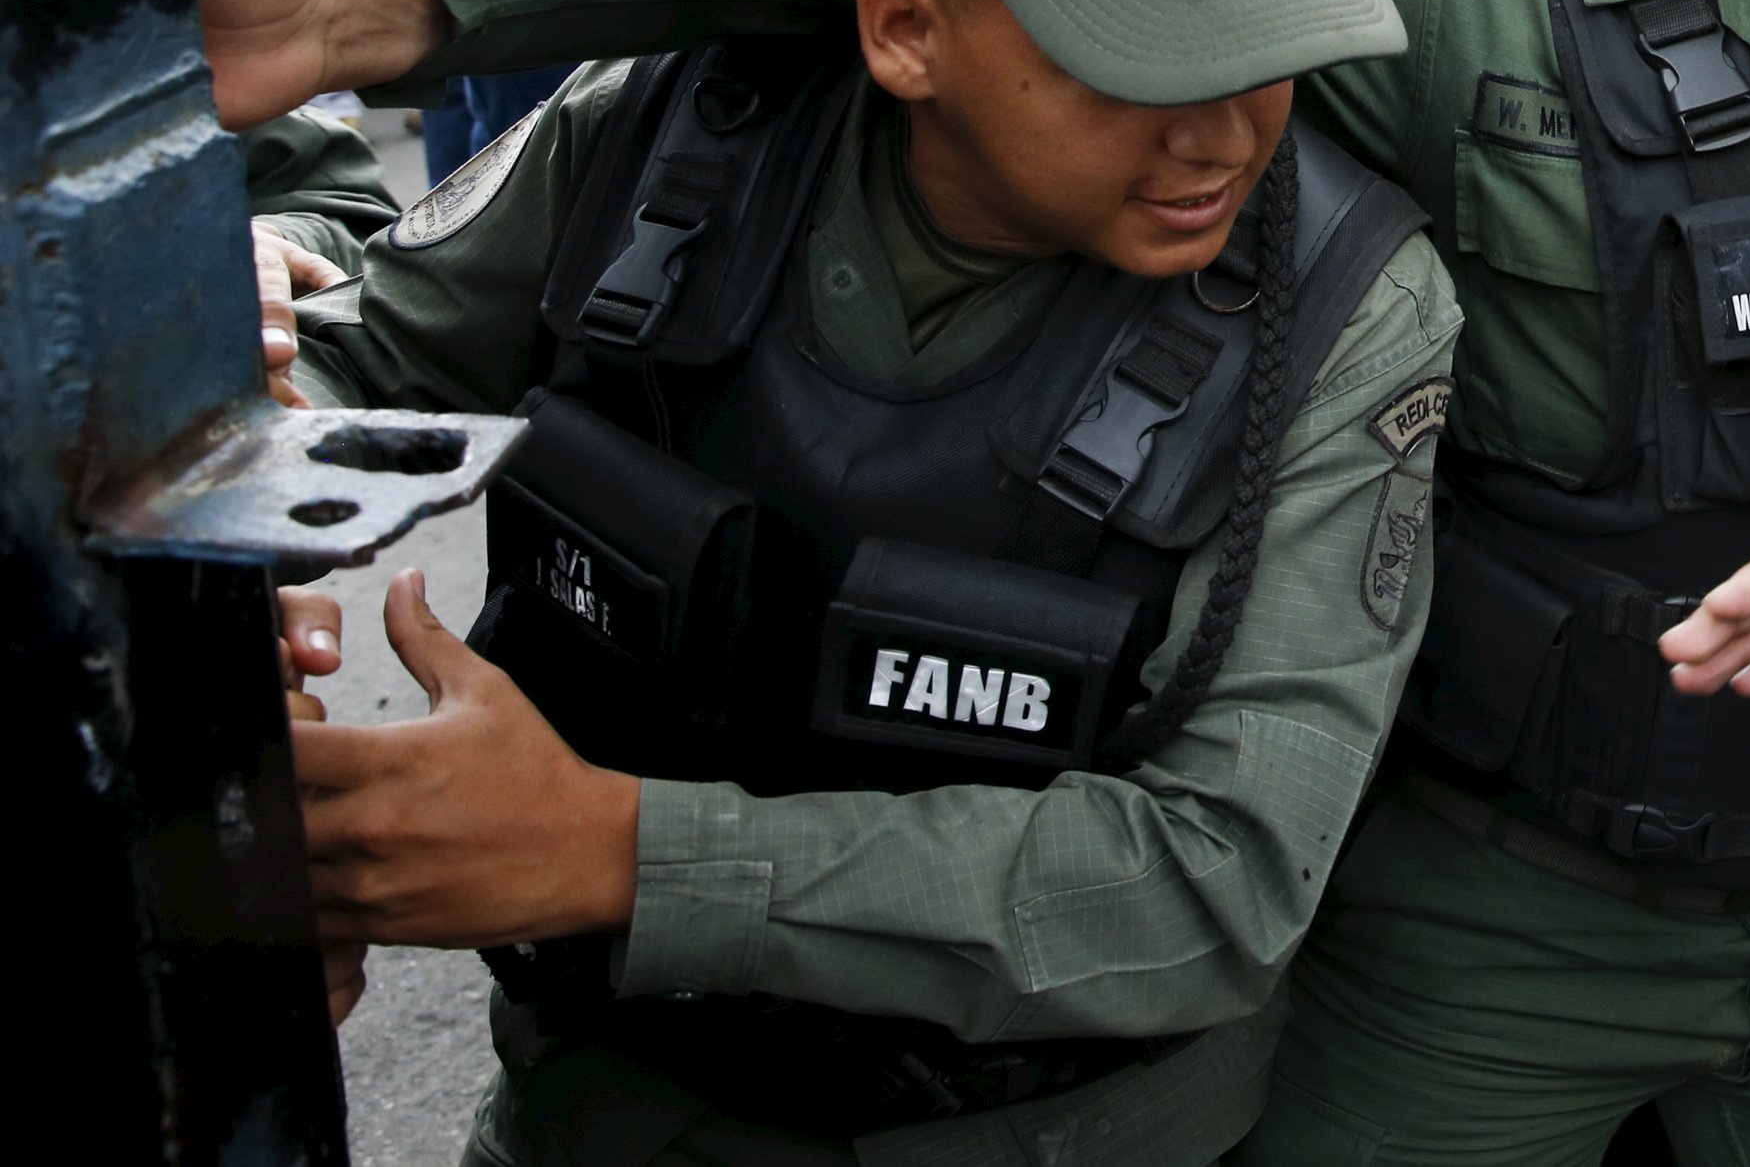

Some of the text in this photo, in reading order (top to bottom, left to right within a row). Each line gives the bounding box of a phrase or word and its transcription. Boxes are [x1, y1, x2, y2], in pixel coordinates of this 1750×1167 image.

[1499, 96, 1526, 132] W.
[1394, 393, 1448, 436] REDI-CE
[556, 537, 591, 586] S/1
[550, 567, 596, 623] SALAS
[868, 649, 1051, 732] FANB
